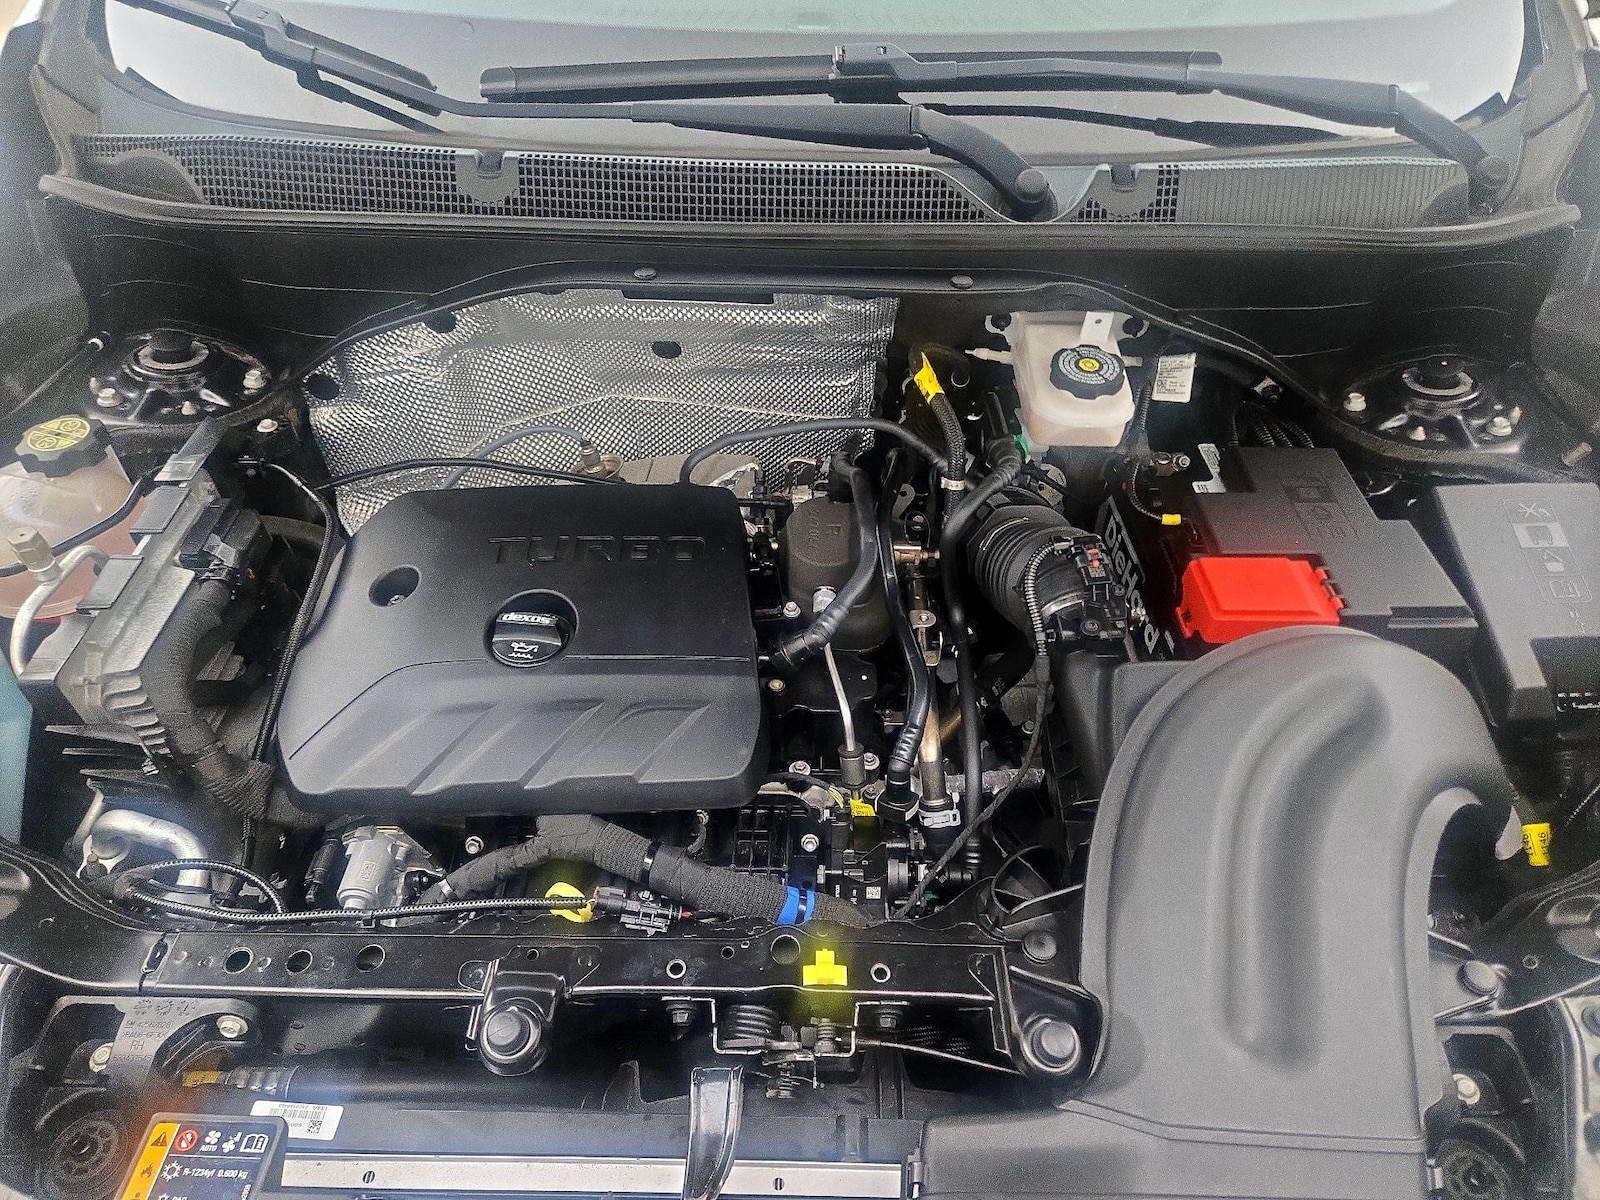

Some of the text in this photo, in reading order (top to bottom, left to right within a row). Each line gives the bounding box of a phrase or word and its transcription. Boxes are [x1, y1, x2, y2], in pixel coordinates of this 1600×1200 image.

[488, 535, 706, 564] TURBO
[502, 612, 551, 624] dexos
[129, 1040, 145, 1051] RH
[199, 1144, 218, 1152] AUTO
[182, 1167, 249, 1180] R-1234yf 0.600 kg
